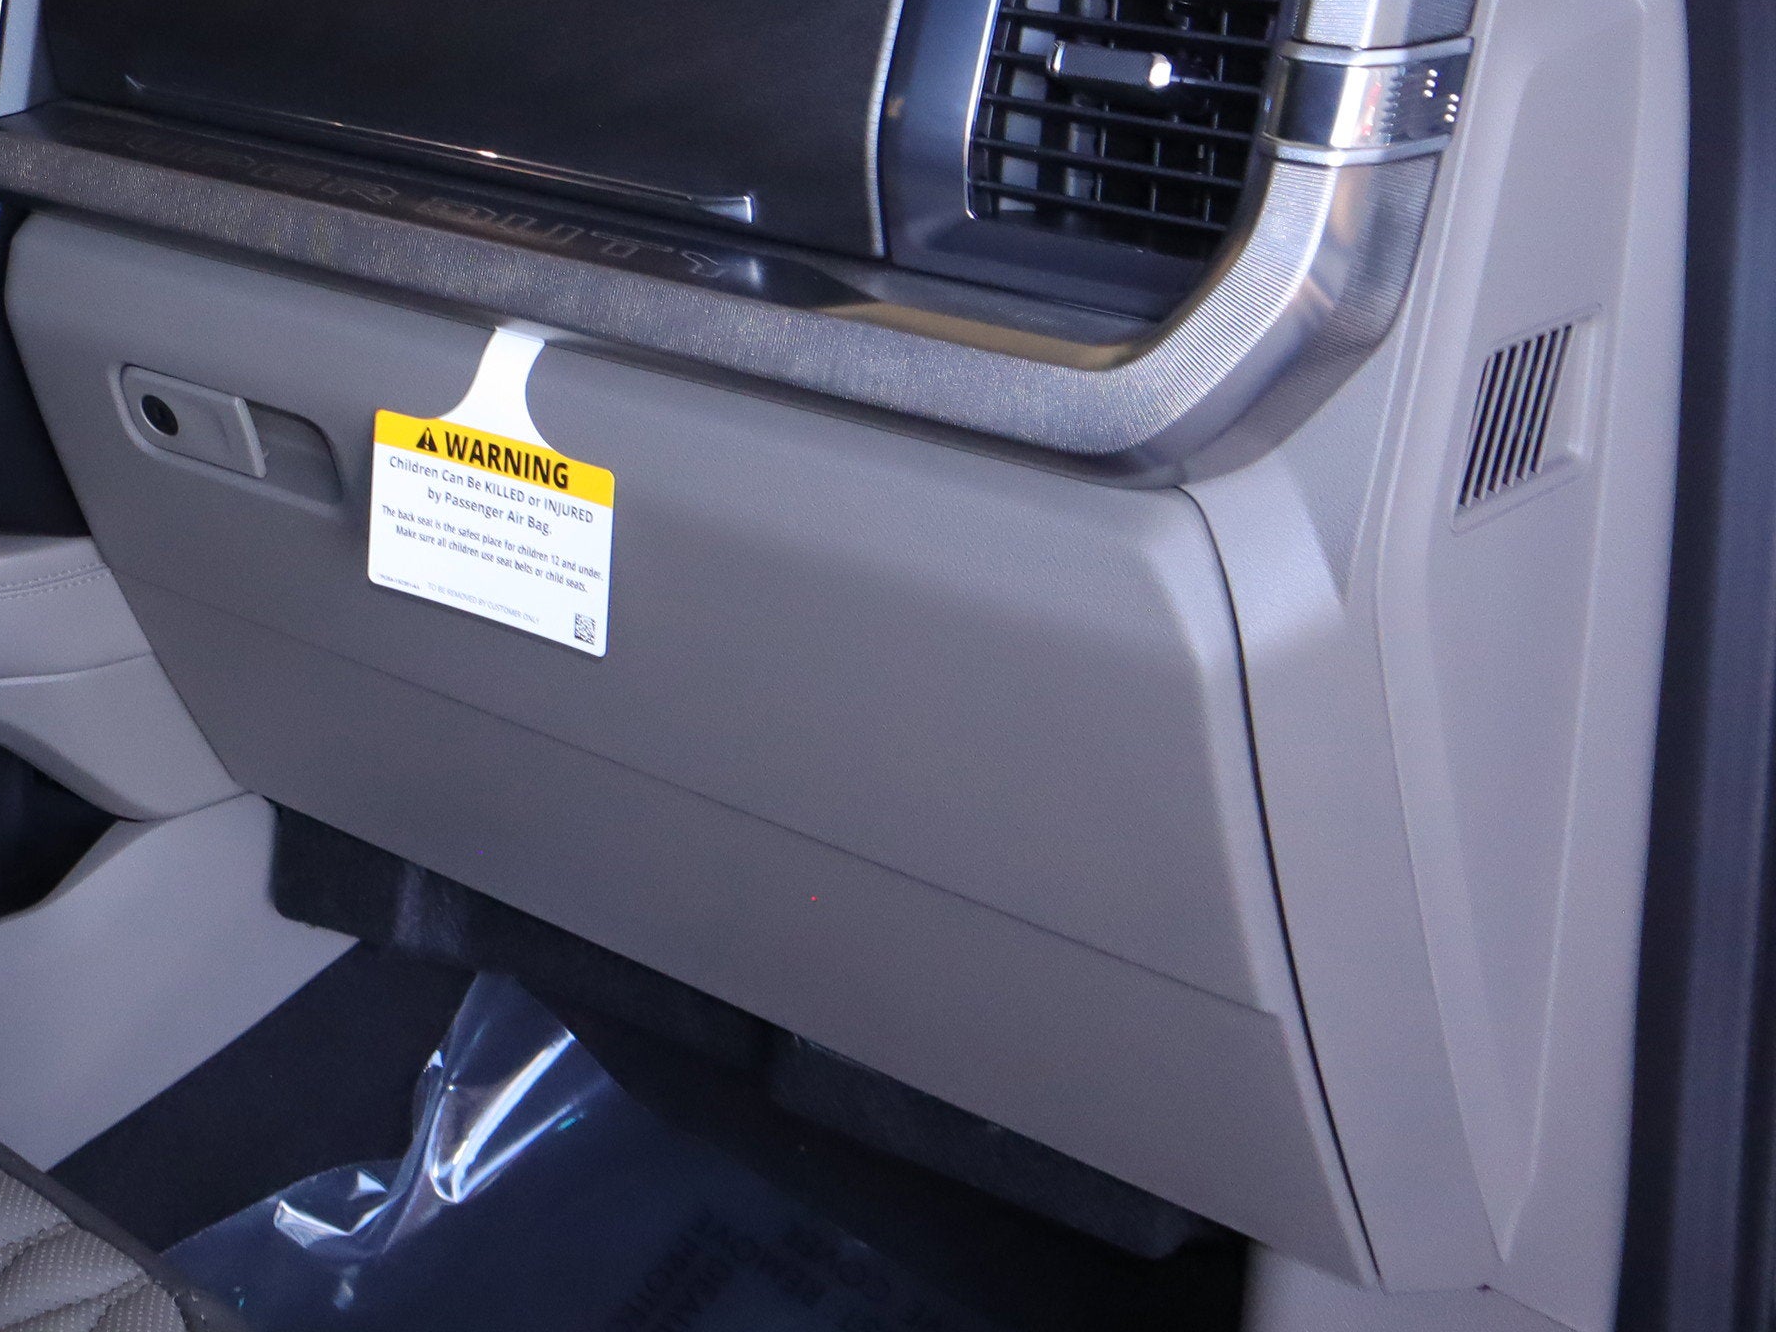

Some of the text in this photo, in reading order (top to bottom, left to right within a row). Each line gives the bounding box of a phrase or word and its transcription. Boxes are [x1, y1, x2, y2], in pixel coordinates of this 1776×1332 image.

[416, 195, 722, 279] DUTY
[389, 456, 594, 523] Children Can Be KILLED or INJURED
[444, 430, 569, 490] WARNING
[382, 504, 604, 581] The back seat is the safest place for children 12 and under.
[427, 486, 552, 537] by Passenger Air Bag.
[396, 524, 588, 593] Make sure all children use seat belts or child seats.
[427, 580, 437, 591] TO
[437, 585, 446, 595] BE
[447, 587, 478, 605] REMOVED
[478, 598, 486, 607] BY
[486, 600, 522, 619] CUSTOMER
[523, 611, 540, 625] ONLY
[690, 1201, 826, 1310] REMOVE
